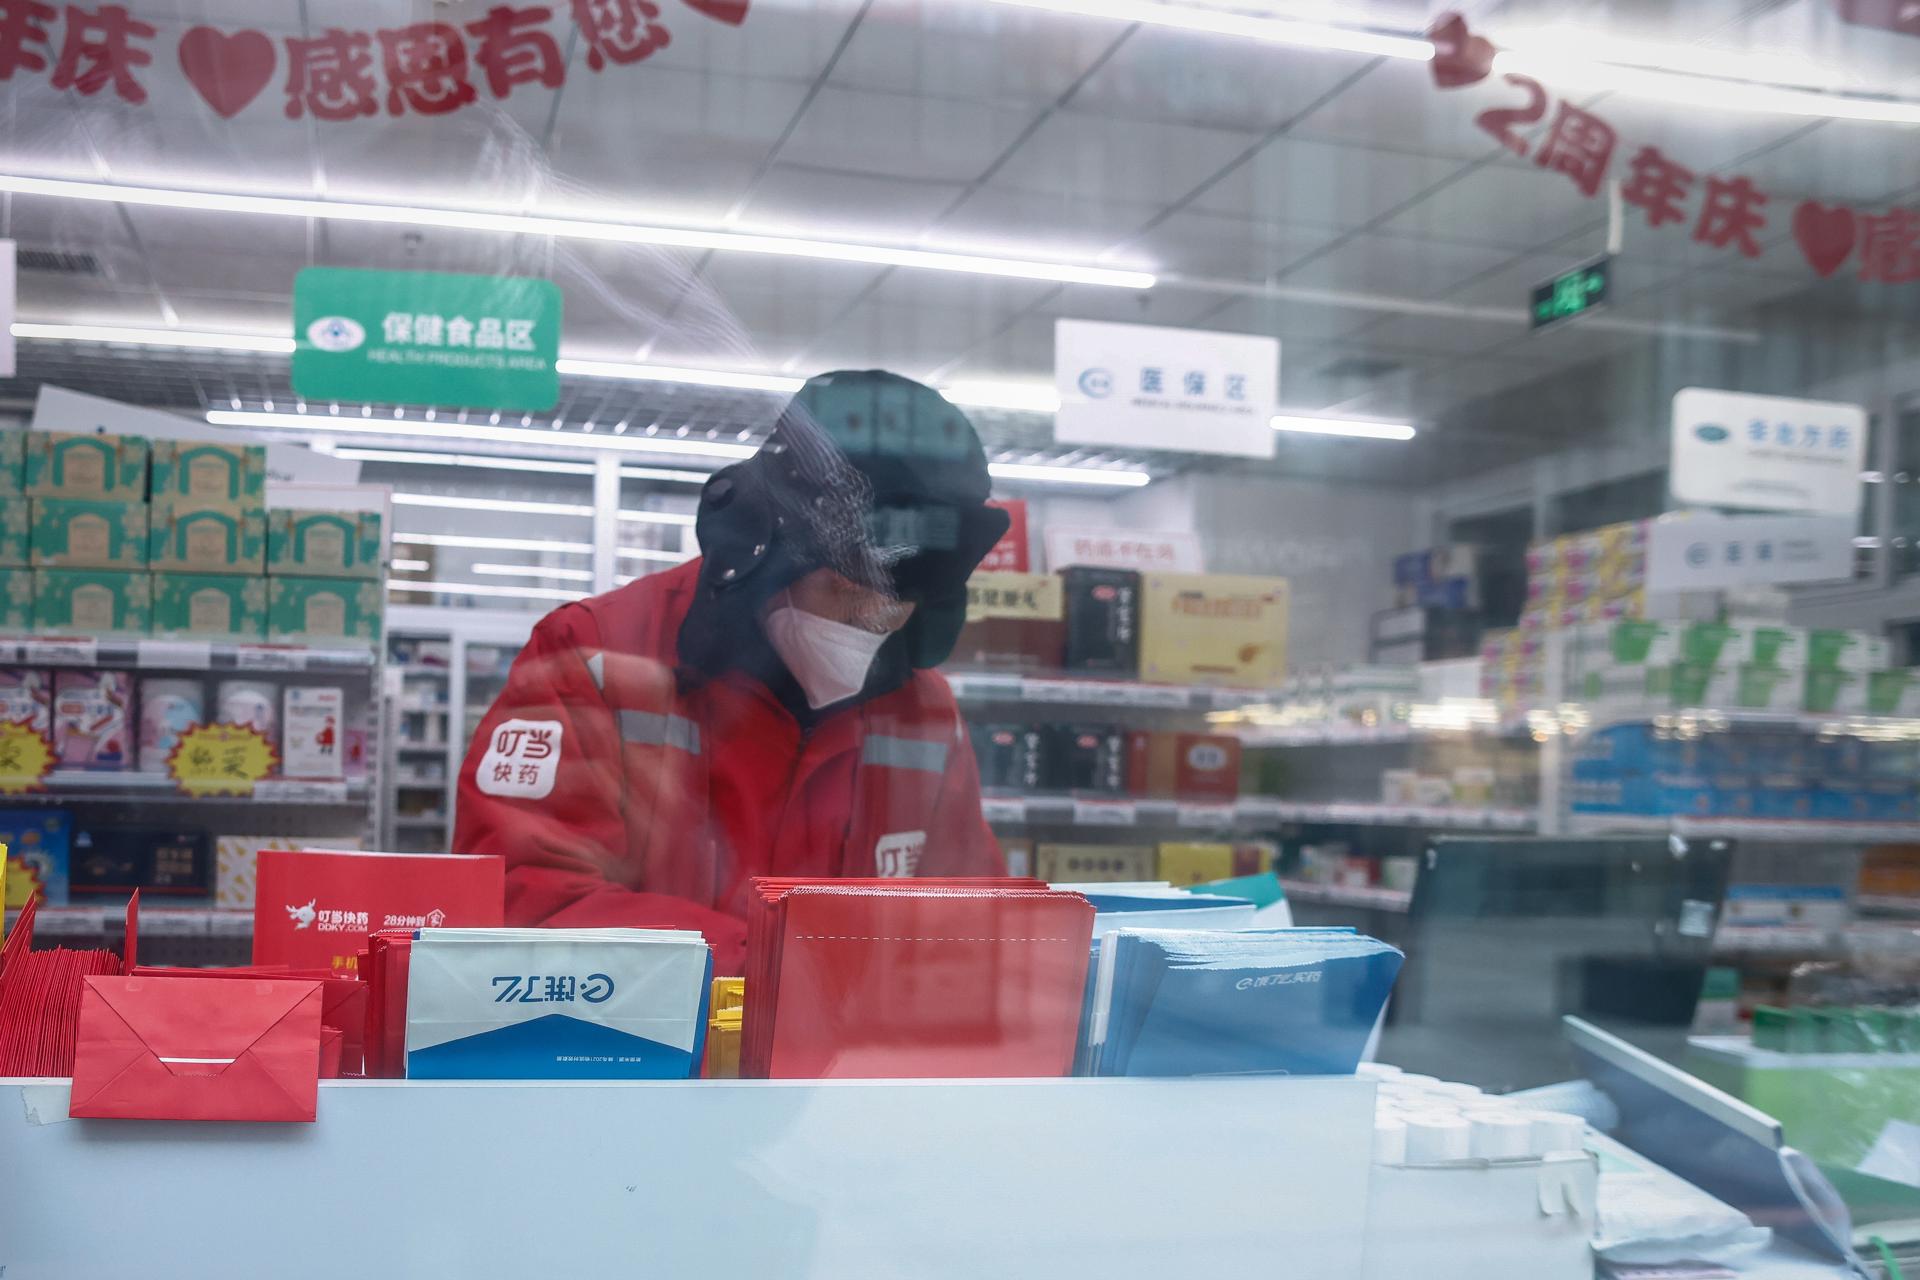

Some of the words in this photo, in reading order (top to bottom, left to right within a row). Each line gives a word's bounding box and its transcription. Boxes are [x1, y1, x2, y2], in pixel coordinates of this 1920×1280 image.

[1474, 72, 1770, 259] 2周年庆
[383, 312, 536, 350] 保健食品区
[1140, 367, 1247, 400] 医保区
[497, 730, 552, 758] 叮当
[493, 762, 540, 785] 快药
[317, 923, 368, 932] DDKY.COM
[318, 910, 369, 924] 叮当快药
[492, 976, 576, 1003] 饿了么
